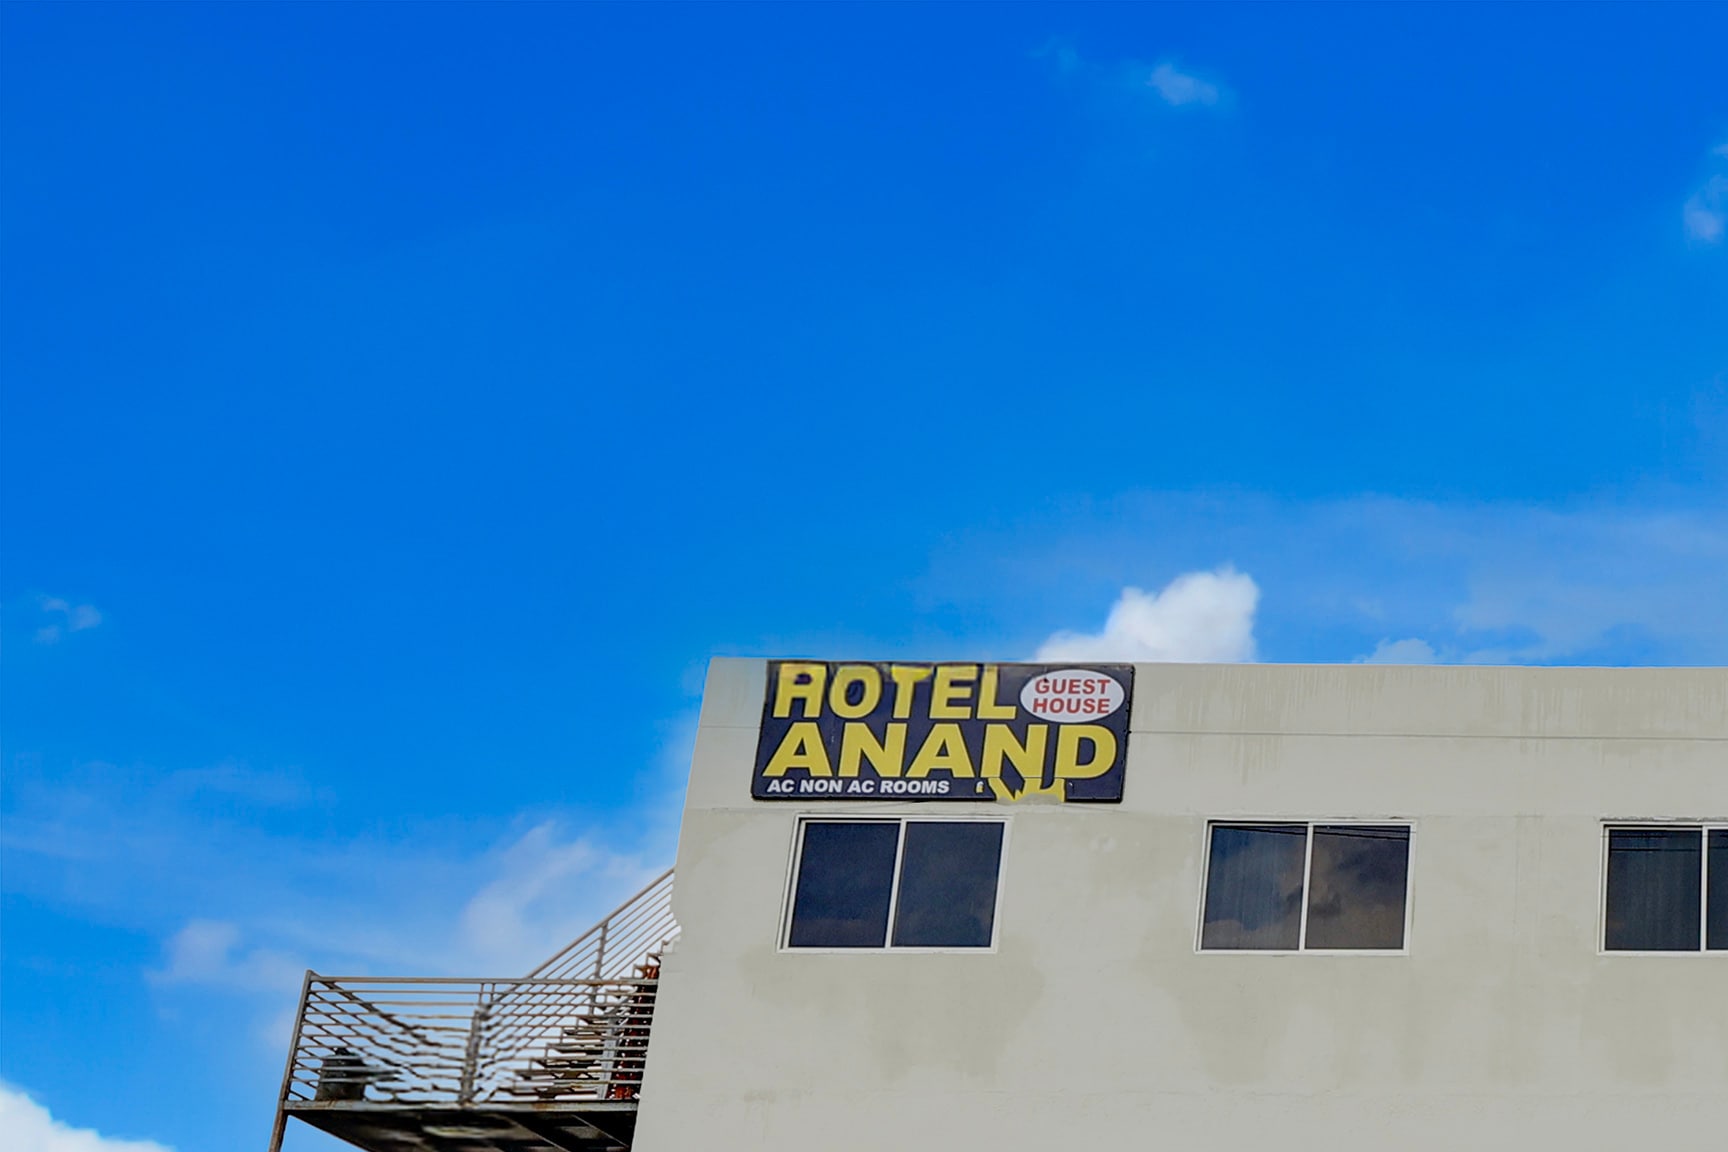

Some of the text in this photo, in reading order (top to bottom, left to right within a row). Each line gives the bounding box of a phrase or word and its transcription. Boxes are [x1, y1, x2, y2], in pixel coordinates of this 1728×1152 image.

[1034, 679, 1111, 695] GUEST
[1032, 698, 1111, 714] HOUSE
[762, 721, 1118, 779] ANAND
[767, 779, 950, 794] AC NON AC ROOMS
